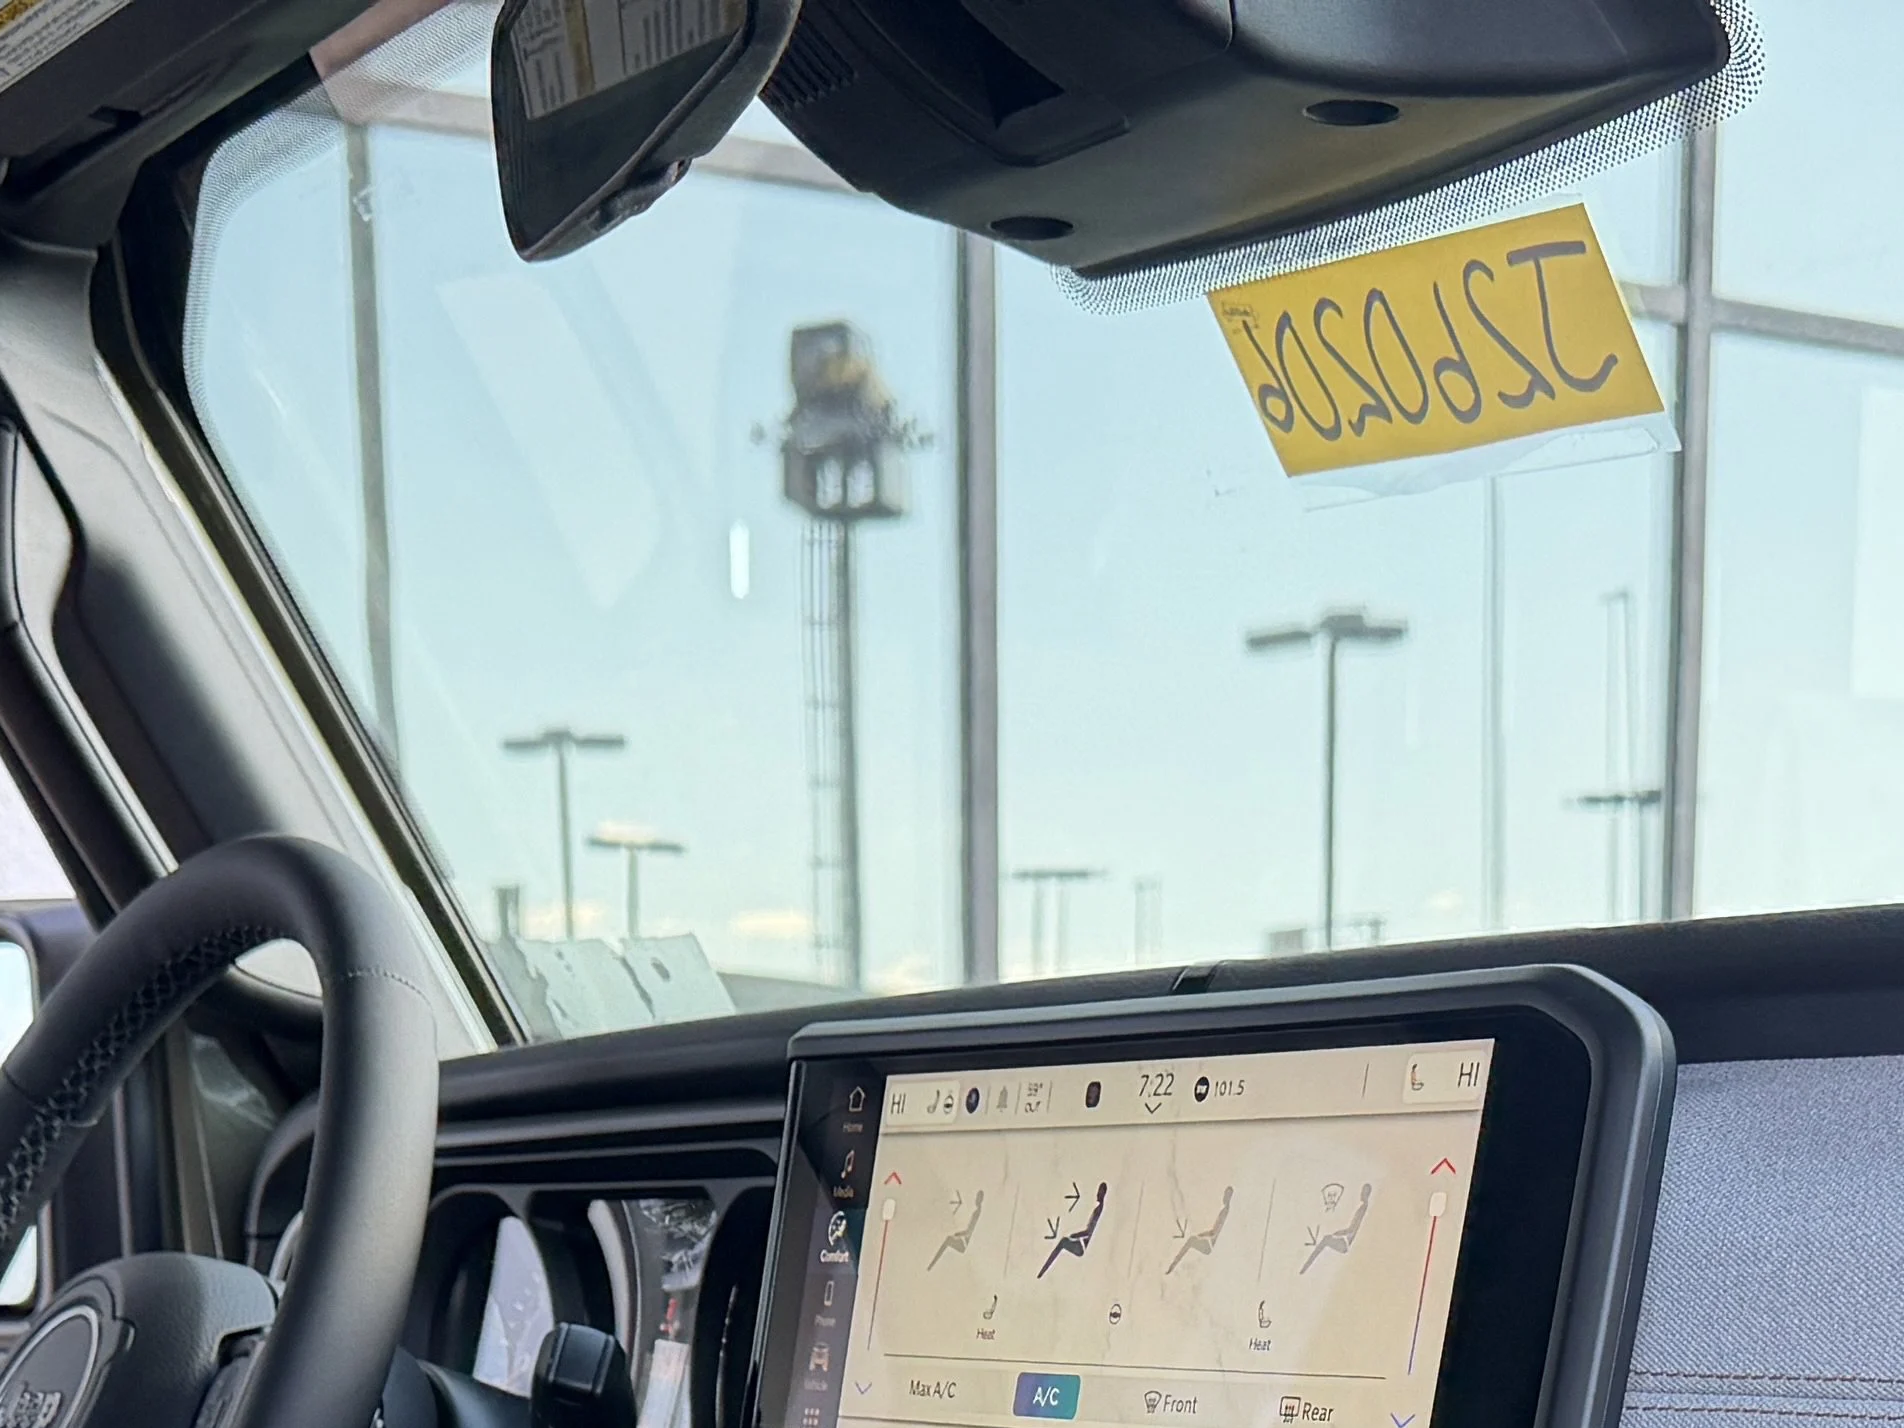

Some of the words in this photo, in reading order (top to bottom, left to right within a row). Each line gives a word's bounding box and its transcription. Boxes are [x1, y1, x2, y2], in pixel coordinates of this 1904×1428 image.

[1457, 1061, 1480, 1088] HI
[1214, 1079, 1245, 1096] 101.5
[890, 1092, 906, 1114] HI
[820, 1249, 849, 1263] Comfort
[976, 1328, 995, 1340] Heat
[1249, 1337, 1271, 1351] Heat
[909, 1379, 931, 1397] Max
[933, 1381, 956, 1399] A/C
[1032, 1386, 1060, 1407] A/C
[1163, 1394, 1197, 1414] Front
[1302, 1402, 1334, 1423] Rear
